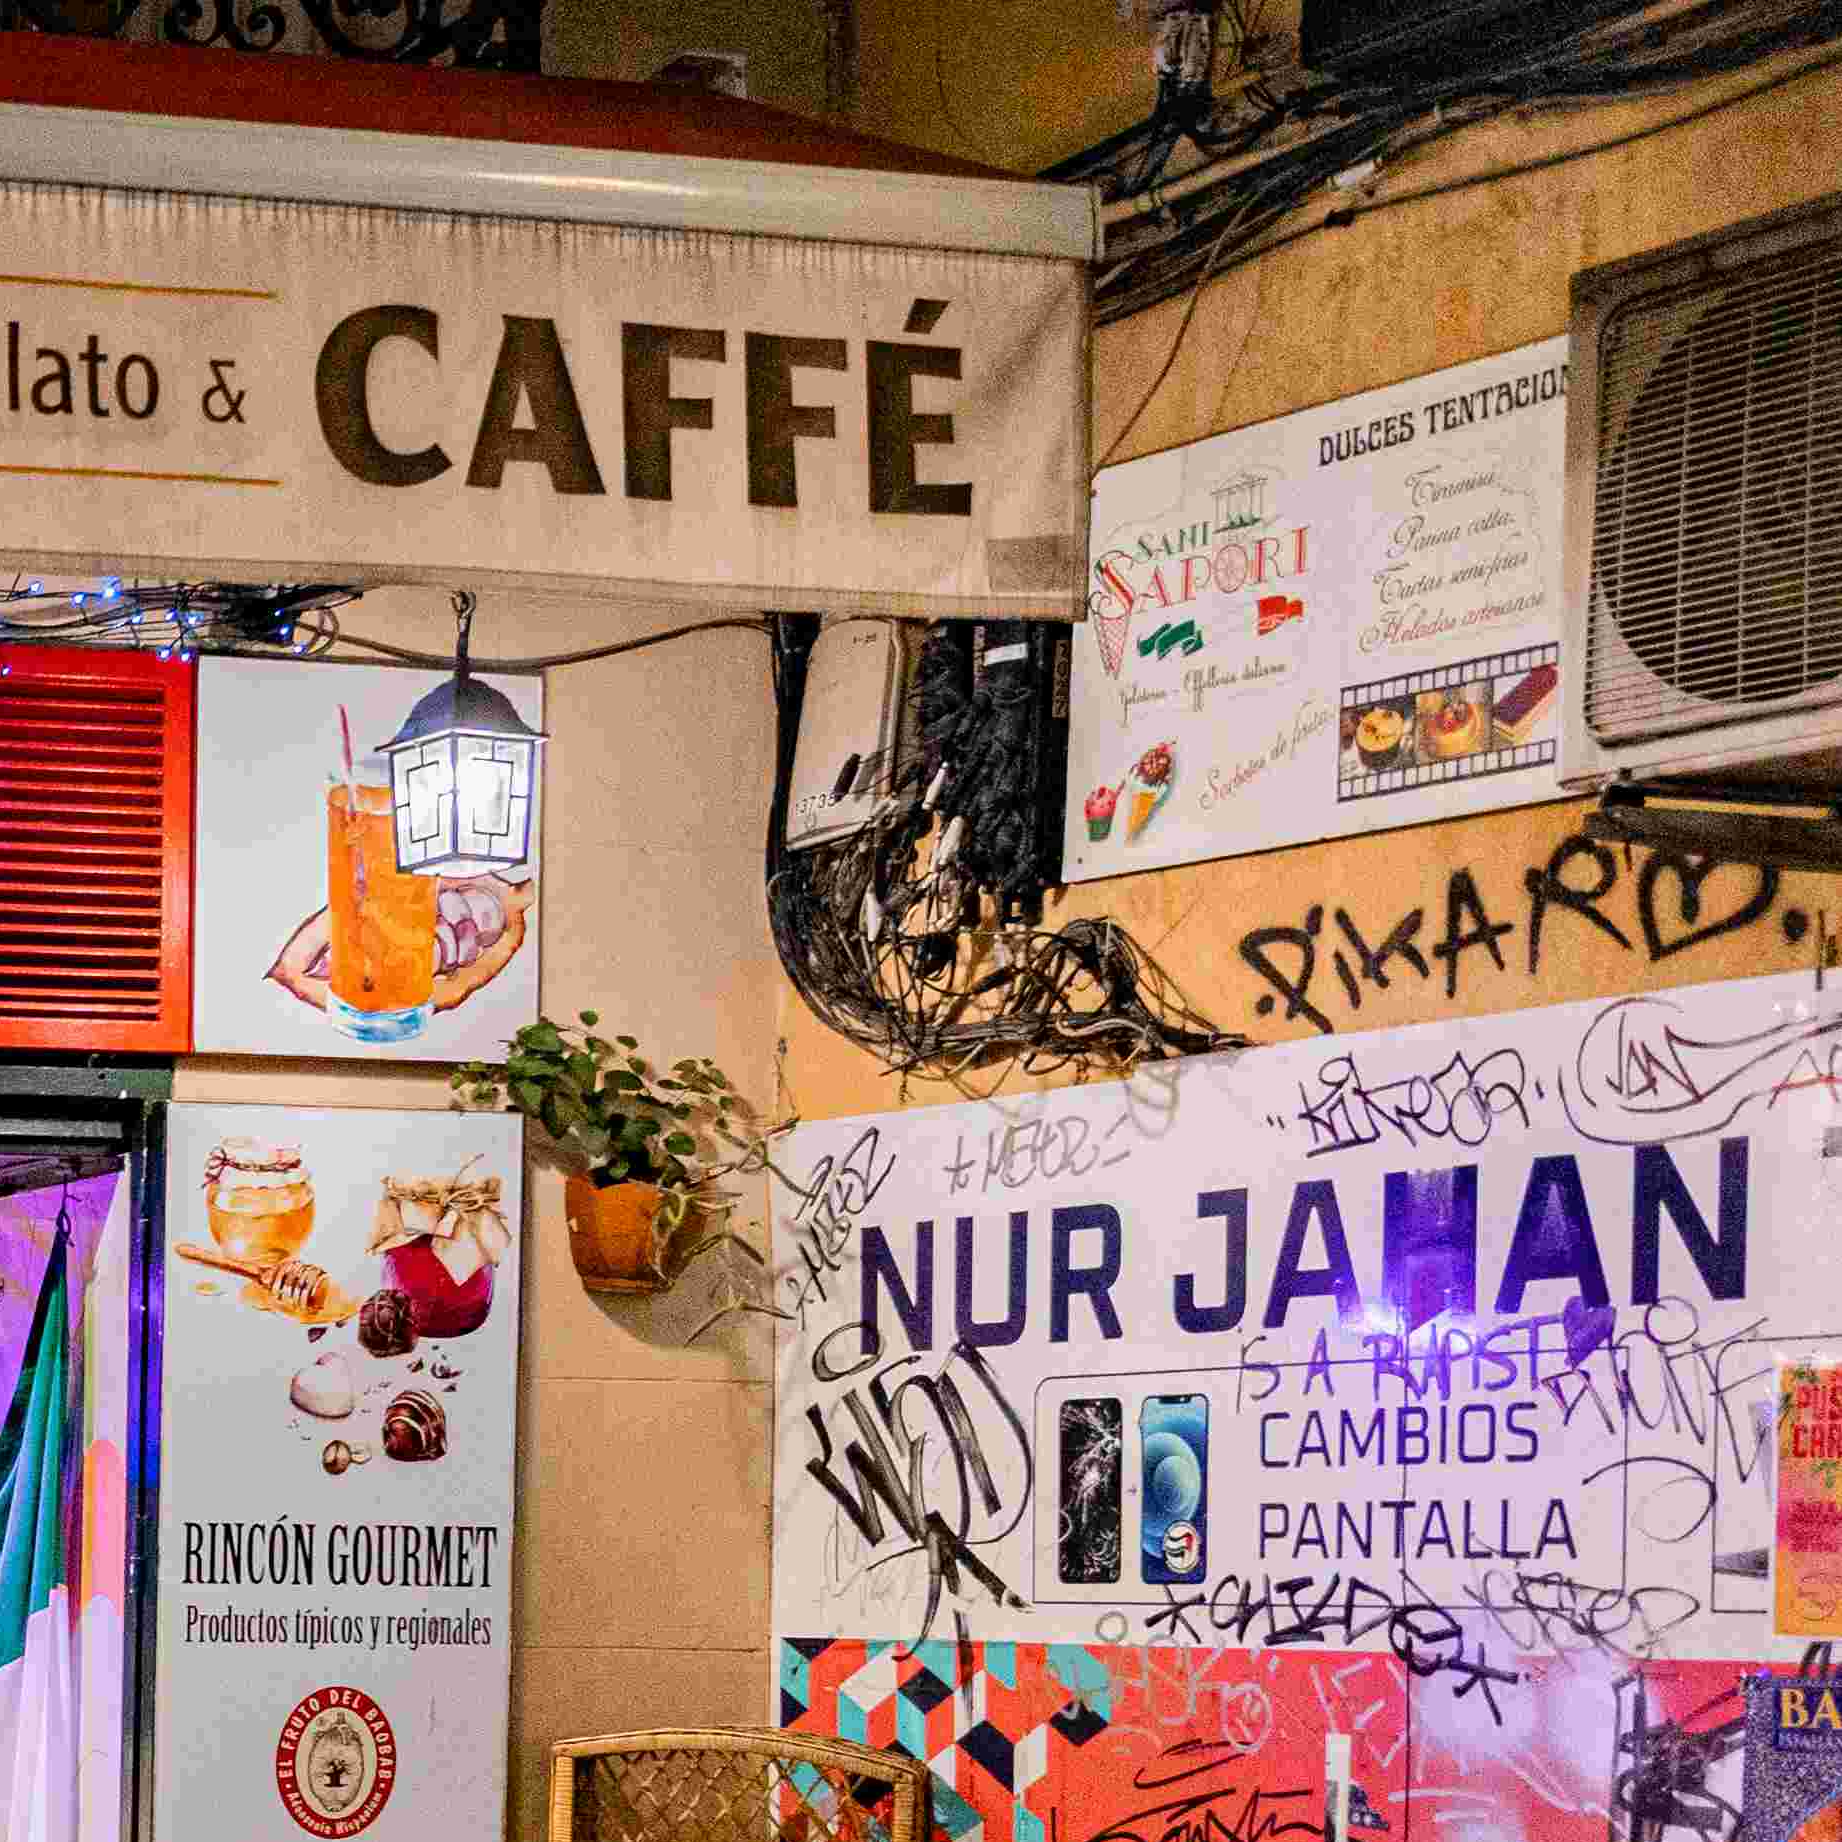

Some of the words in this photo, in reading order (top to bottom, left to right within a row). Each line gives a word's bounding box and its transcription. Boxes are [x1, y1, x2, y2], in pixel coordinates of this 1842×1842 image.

[201, 357, 248, 427] &
[314, 298, 976, 517] CAFFÉ
[1318, 411, 1415, 467] DULCES
[1424, 364, 1569, 435] TENTACION
[1088, 525, 1311, 619] SAPORI
[1133, 521, 1212, 560] SANI
[858, 1203, 1122, 1353] NUR
[1173, 1136, 1748, 1334] JAHAN
[1260, 1403, 1538, 1469] CAMBIOS
[182, 1515, 315, 1585] RINCÓN
[328, 1524, 498, 1588] GOURMET
[1259, 1501, 1578, 1559] PANTALLA
[185, 1606, 288, 1643] Productos
[295, 1608, 364, 1650] típicos
[370, 1617, 380, 1650] y
[385, 1608, 492, 1651] regionales
[281, 1698, 320, 1750] FRUTO
[330, 1689, 360, 1708] DEL
[278, 1759, 293, 1779] EL
[366, 1708, 393, 1779] BAOBAB
